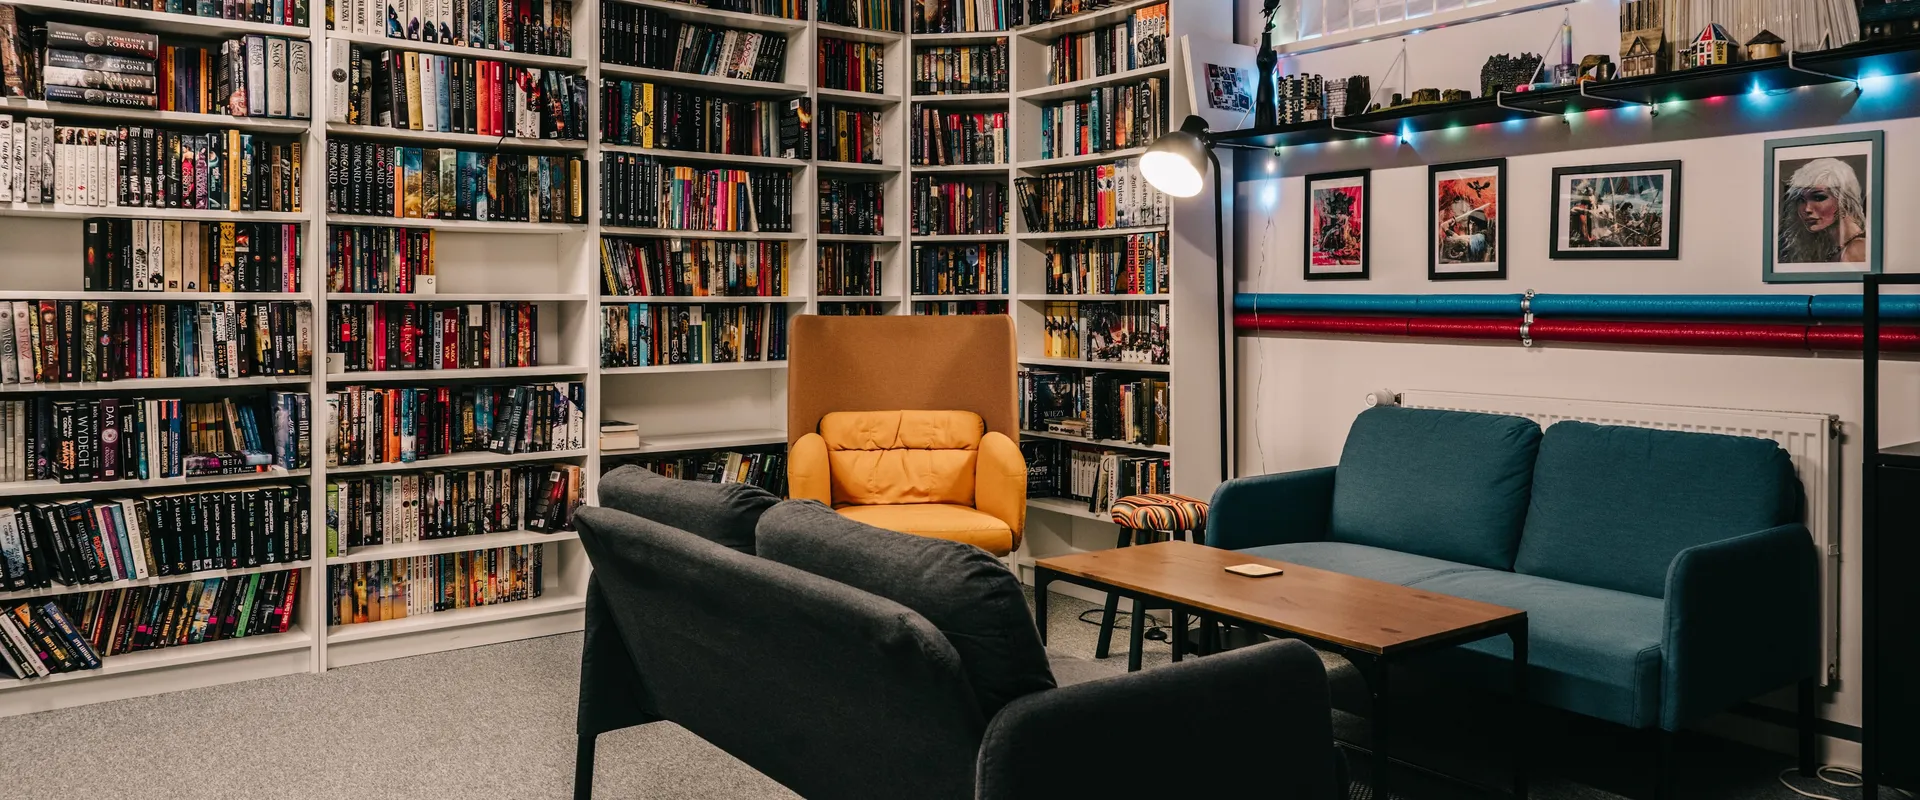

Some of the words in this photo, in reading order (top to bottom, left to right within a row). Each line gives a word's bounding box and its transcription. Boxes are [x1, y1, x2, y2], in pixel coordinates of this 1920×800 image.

[106, 41, 146, 51] KORONA
[107, 62, 146, 71] KORONA
[104, 75, 143, 84] KORONA
[106, 92, 146, 100] WOJENNA
[106, 97, 146, 107] KORONA
[329, 157, 338, 184] CARD
[339, 159, 349, 185] CARD
[353, 158, 362, 183] CARD
[365, 159, 373, 183] CARD
[376, 161, 385, 184] CARD
[386, 162, 394, 189] CARD
[404, 334, 412, 357] BOGA
[105, 405, 115, 428] DAR
[77, 416, 90, 467] WYDECH
[299, 420, 309, 441] ROAR
[222, 467, 243, 475] BETA
[92, 535, 107, 568] REKURSJA
